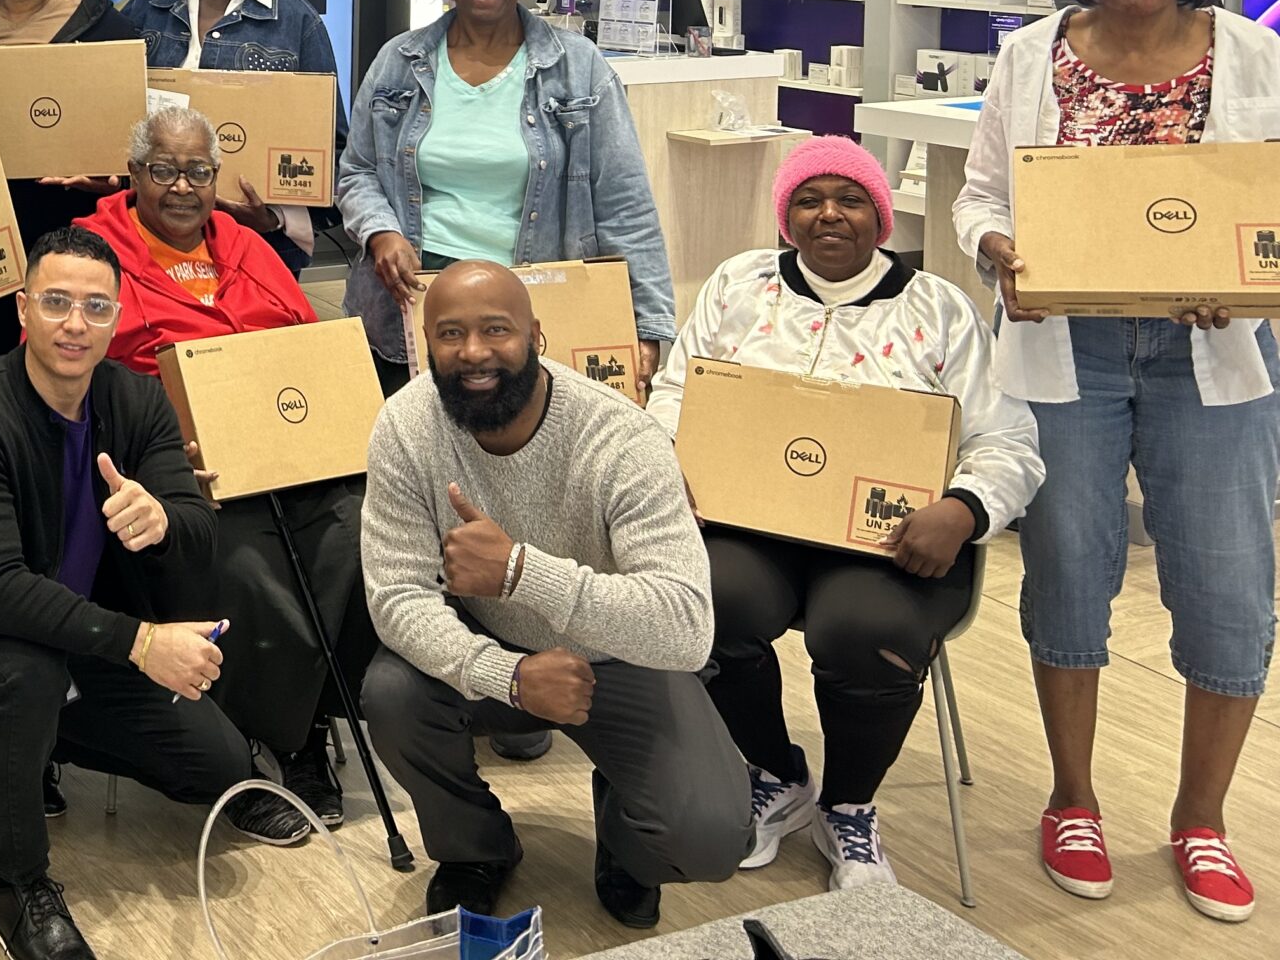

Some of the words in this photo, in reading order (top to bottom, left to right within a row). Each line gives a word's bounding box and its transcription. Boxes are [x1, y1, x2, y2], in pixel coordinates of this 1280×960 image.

[34, 108, 58, 118] DELL
[219, 134, 243, 143] DELL
[279, 179, 292, 188] UN
[293, 180, 312, 189] 3481
[1153, 210, 1192, 221] DELL
[1258, 260, 1279, 270] UN
[174, 260, 197, 283] PARK
[281, 401, 305, 412] DELL
[790, 450, 822, 465] DELL
[866, 518, 883, 530] UN
